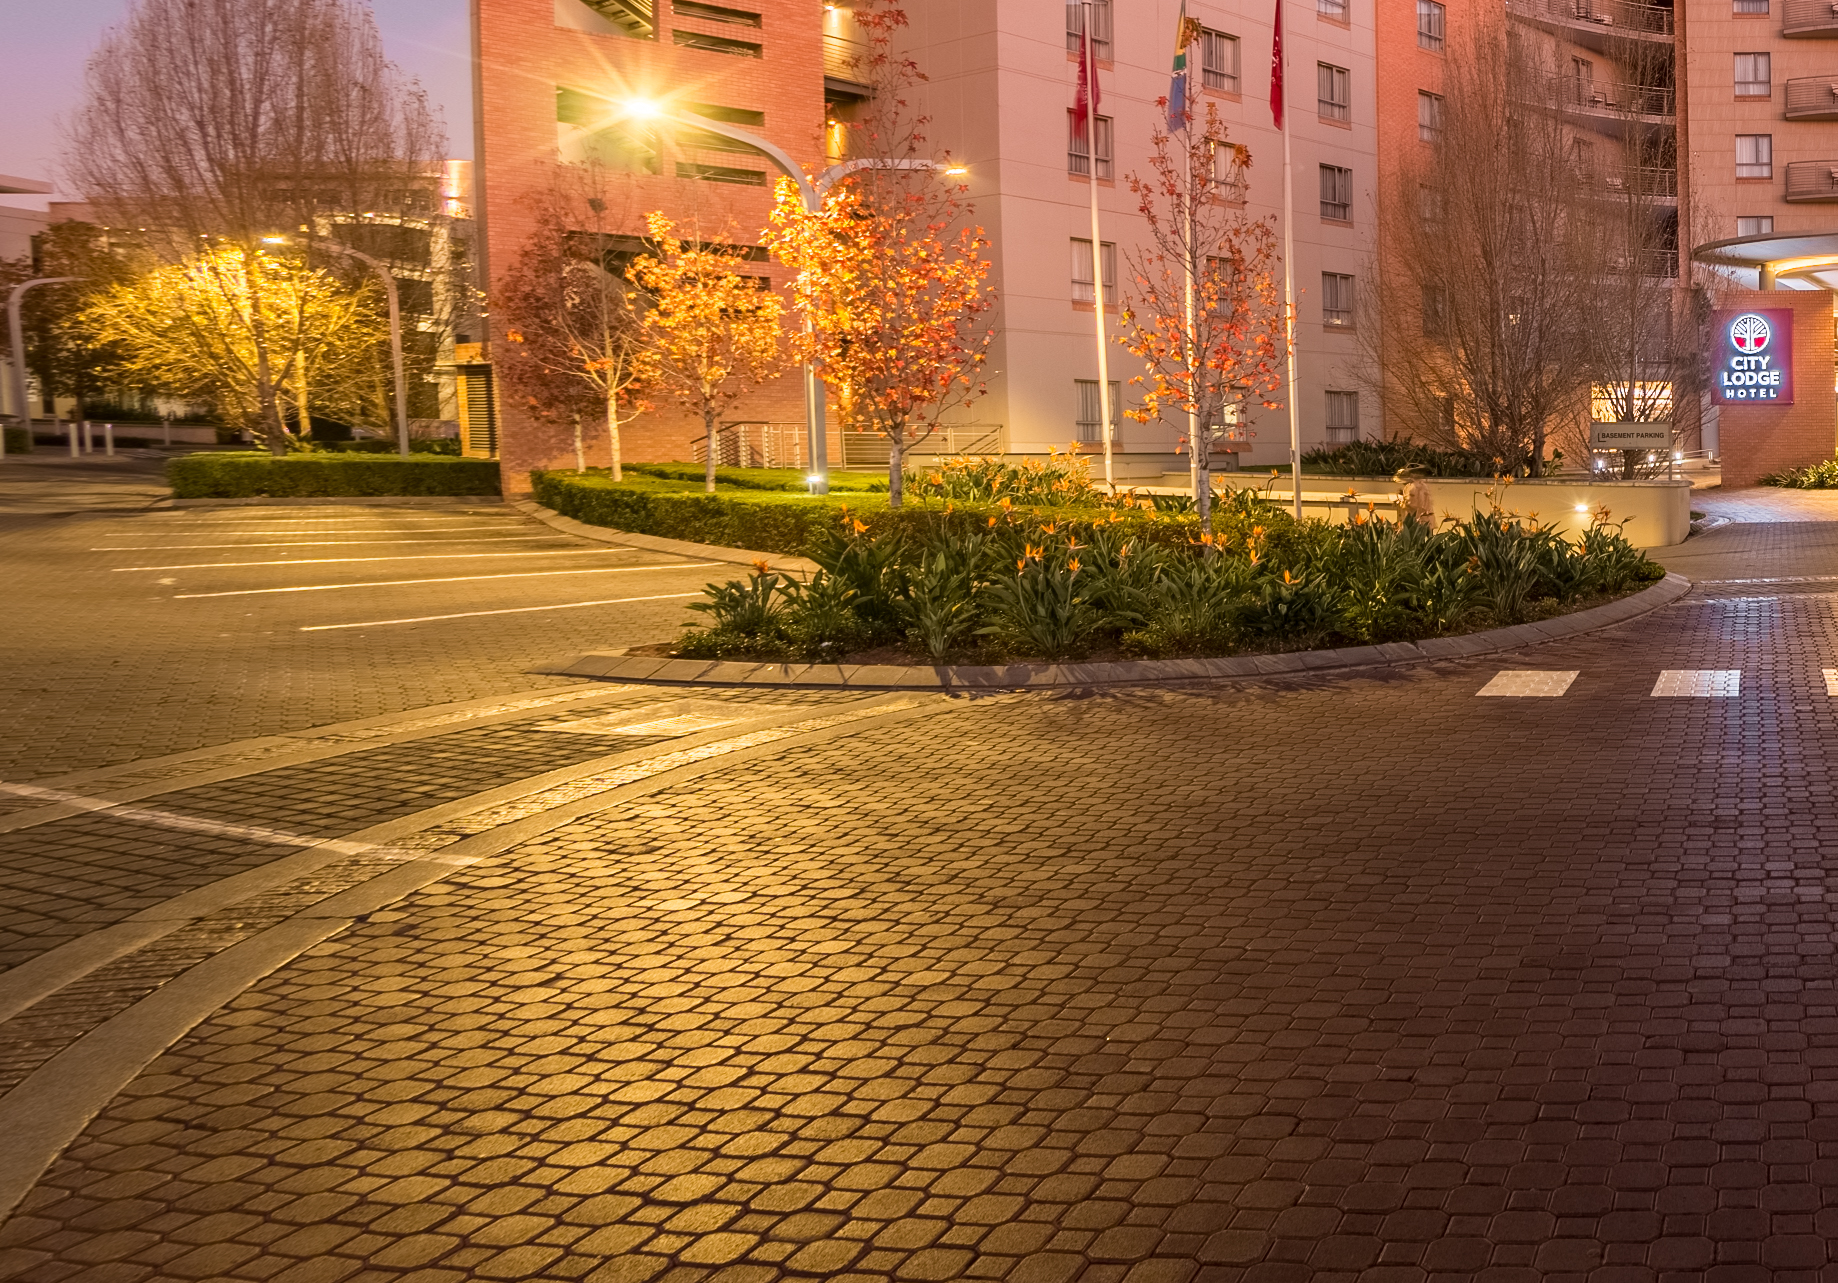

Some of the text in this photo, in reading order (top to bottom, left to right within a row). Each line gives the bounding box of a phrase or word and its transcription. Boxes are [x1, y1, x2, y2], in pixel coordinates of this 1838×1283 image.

[1731, 355, 1770, 371] CITY
[1723, 370, 1781, 386] LODGE
[1725, 388, 1777, 399] HOTEL
